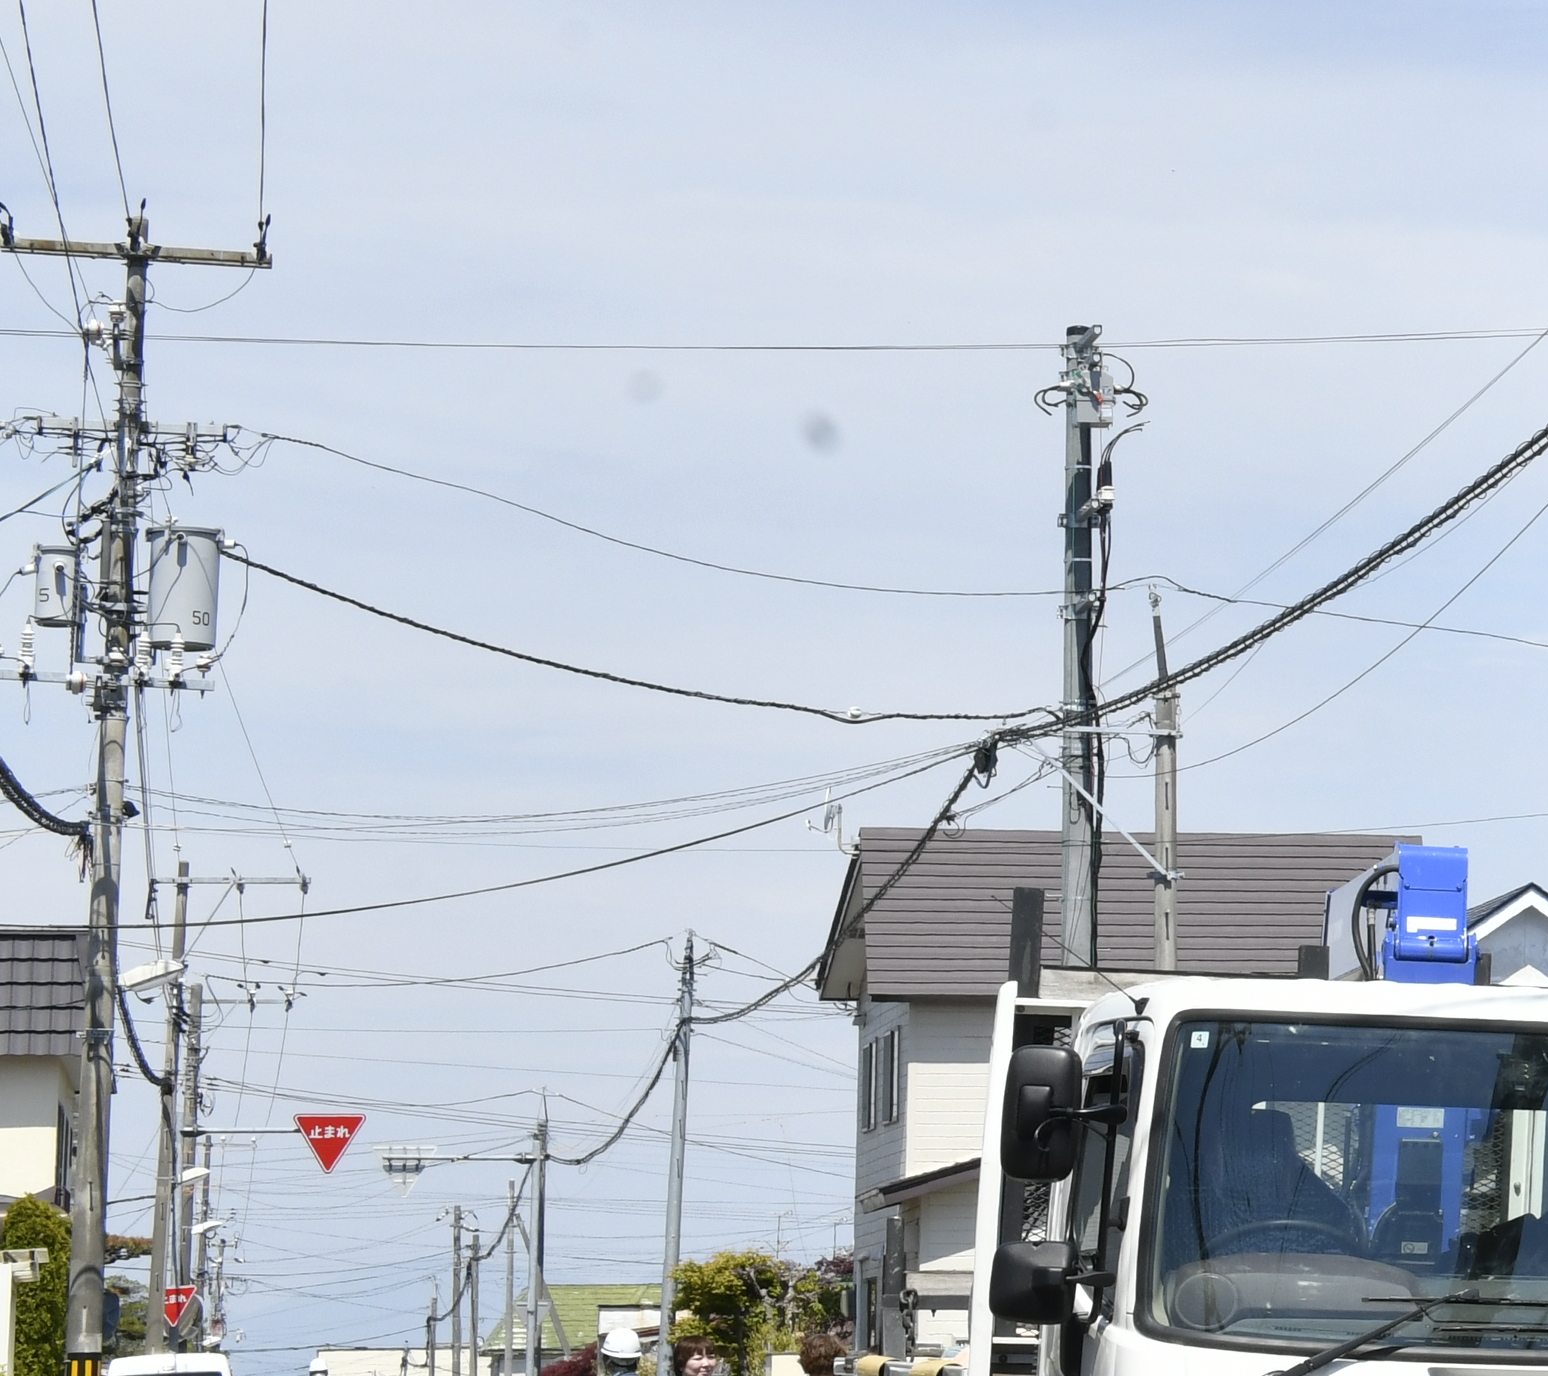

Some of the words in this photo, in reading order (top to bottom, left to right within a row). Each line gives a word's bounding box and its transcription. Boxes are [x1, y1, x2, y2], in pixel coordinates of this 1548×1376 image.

[39, 588, 50, 603] 5
[192, 610, 210, 626] 50
[308, 1124, 351, 1139] 止まれ
